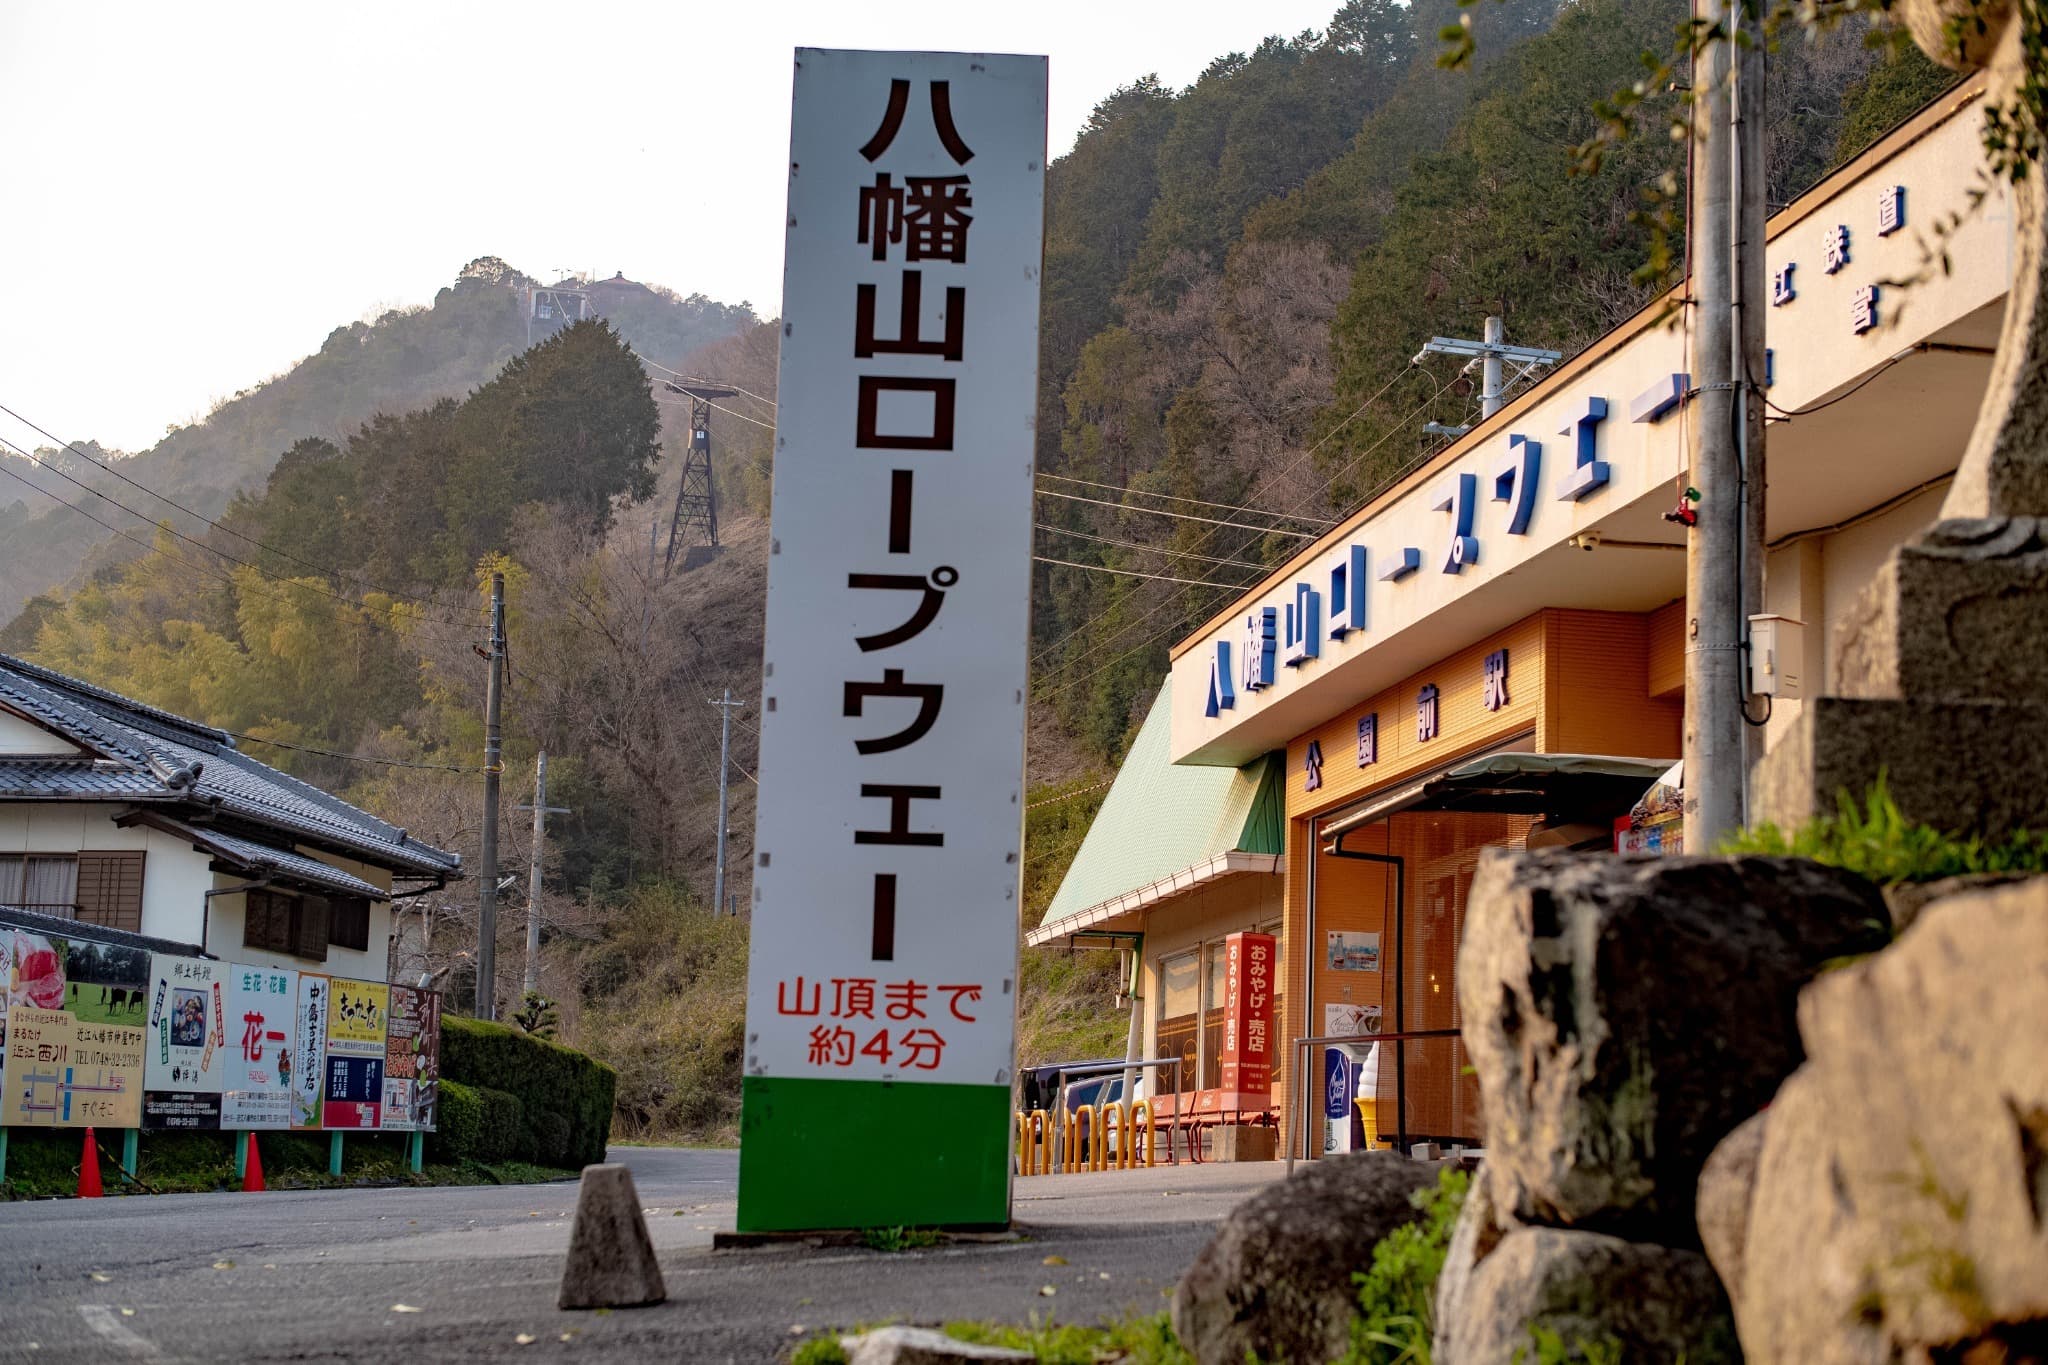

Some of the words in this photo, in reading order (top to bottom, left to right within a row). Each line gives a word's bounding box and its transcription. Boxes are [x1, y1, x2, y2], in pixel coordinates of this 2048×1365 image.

[1304, 649, 1509, 792] 公園前駅
[777, 976, 983, 1024] 山頂まで
[1247, 944, 1267, 1053] おみやげ・売店
[13, 1028, 41, 1041] まるたけ
[241, 1010, 287, 1063] 花一
[808, 1024, 947, 1071] 約4分
